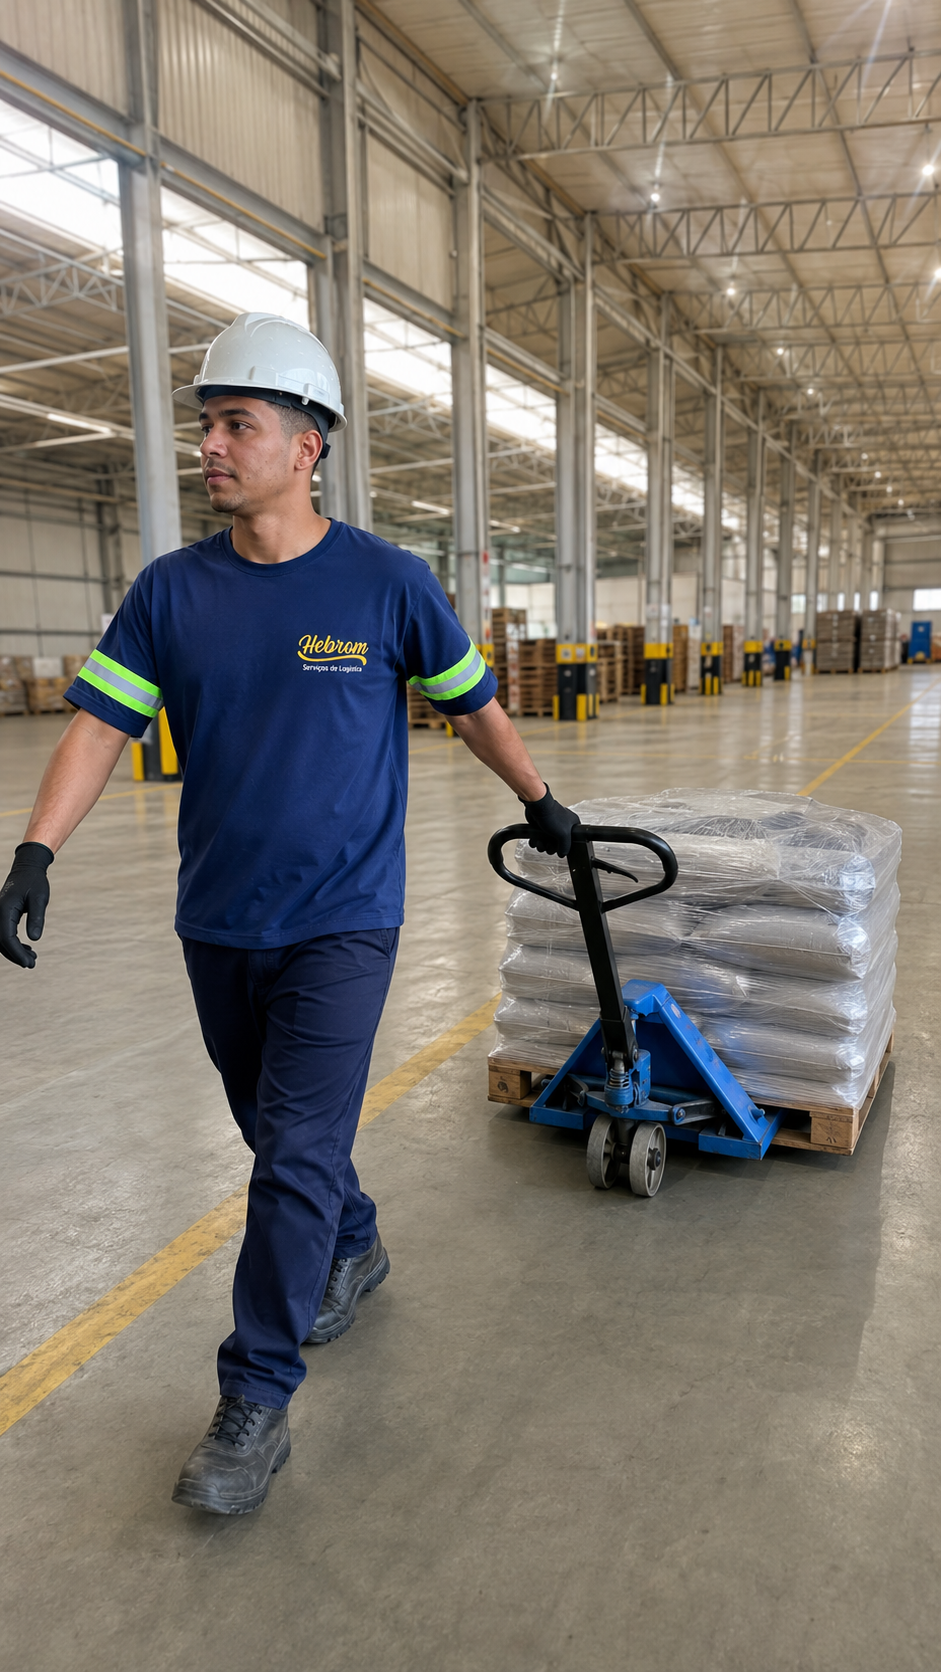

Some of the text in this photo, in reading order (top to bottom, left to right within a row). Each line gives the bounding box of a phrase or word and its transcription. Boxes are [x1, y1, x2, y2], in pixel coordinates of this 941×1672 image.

[298, 634, 369, 655] Hebrom
[303, 663, 328, 674] Serviços
[330, 664, 339, 672] de
